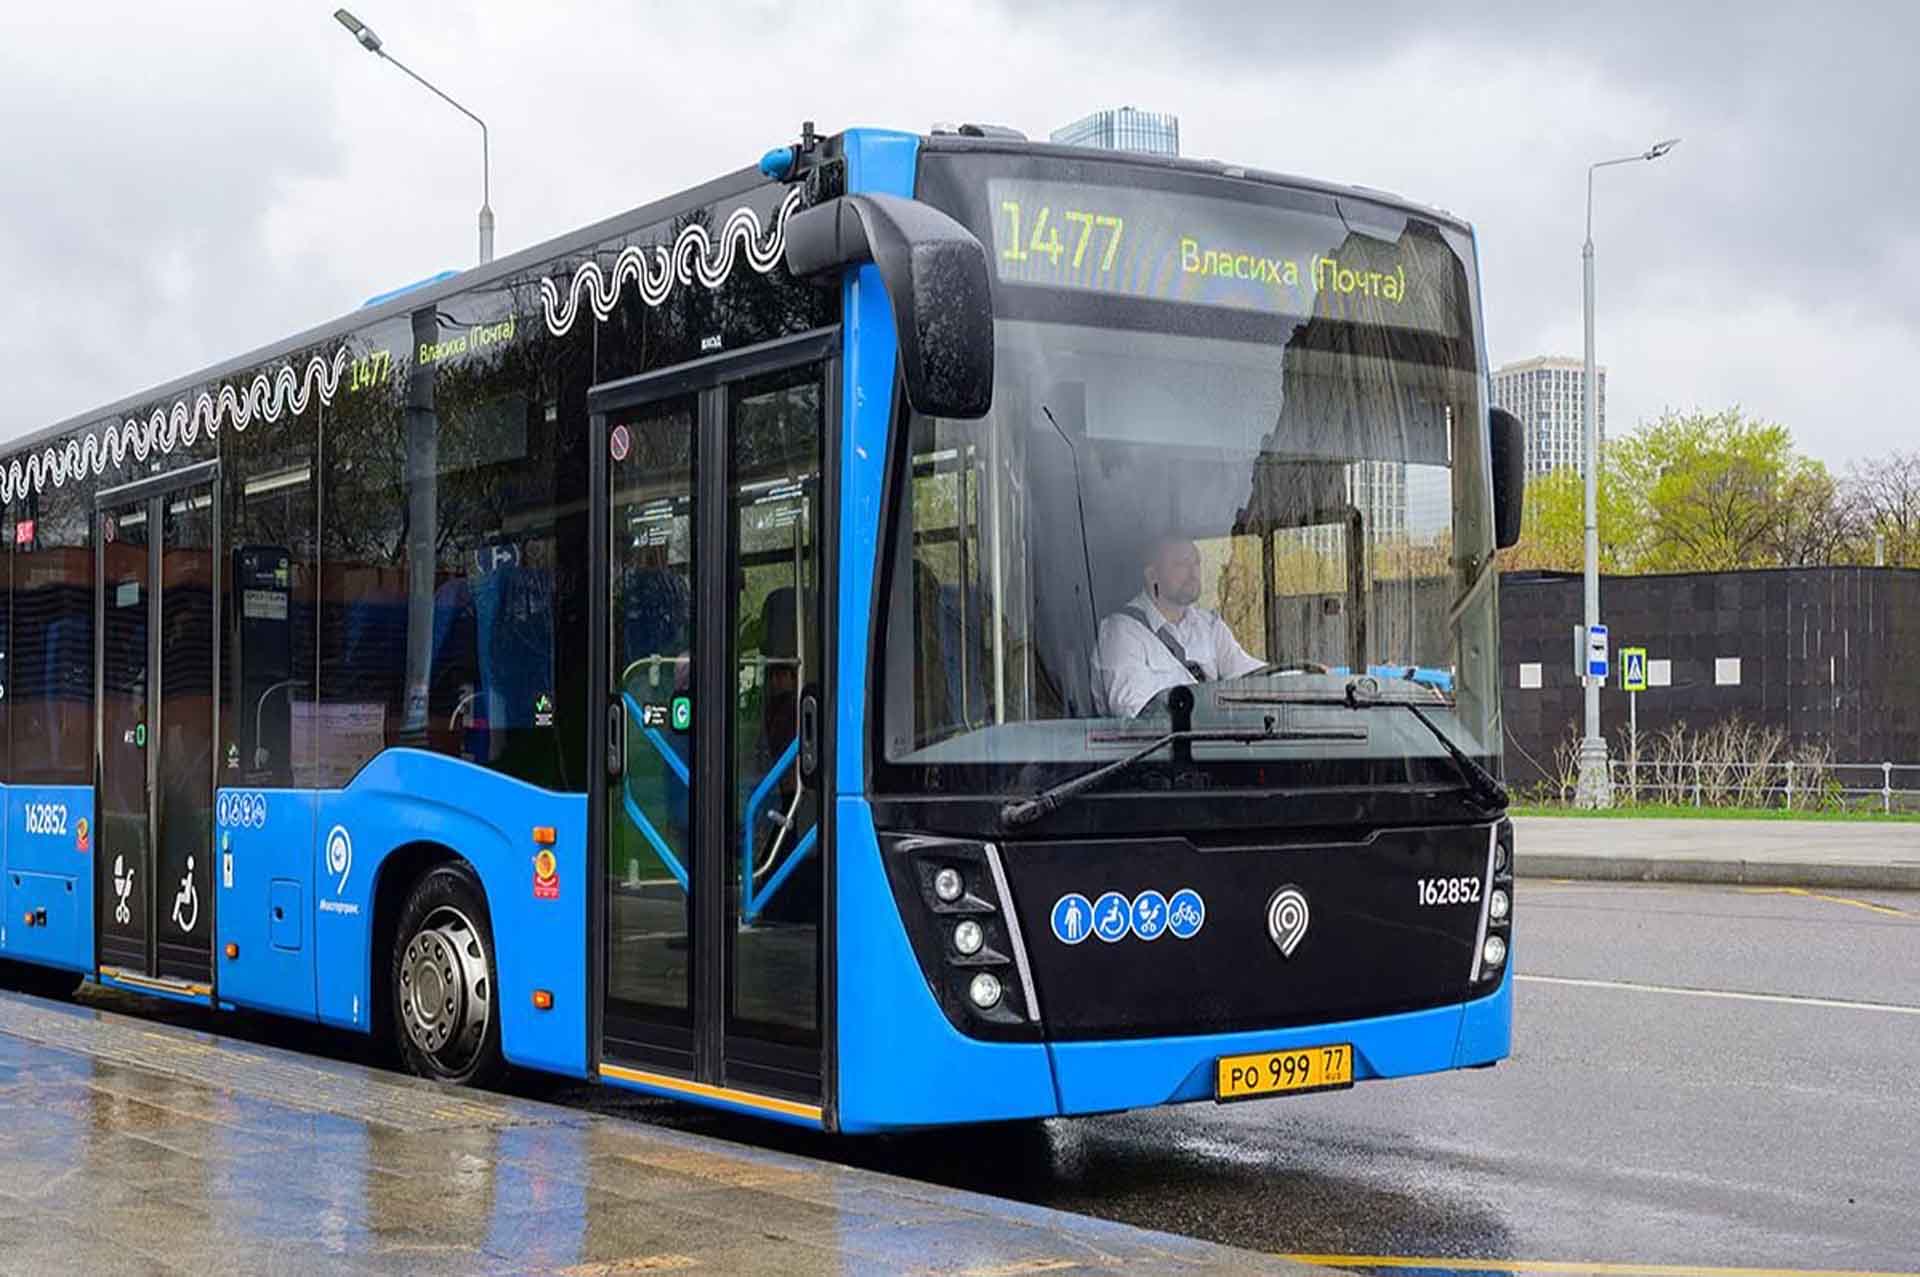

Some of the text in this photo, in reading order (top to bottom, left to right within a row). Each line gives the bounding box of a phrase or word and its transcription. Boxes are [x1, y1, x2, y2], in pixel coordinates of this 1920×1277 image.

[1002, 201, 1407, 303] 1477 Власиха (Почта)
[351, 315, 515, 391] 1477 Власиха (Почта)
[25, 803, 67, 836] 162852
[1417, 876, 1480, 906] 162852
[1268, 1054, 1310, 1087] 999
[1323, 1048, 1343, 1072] 77
